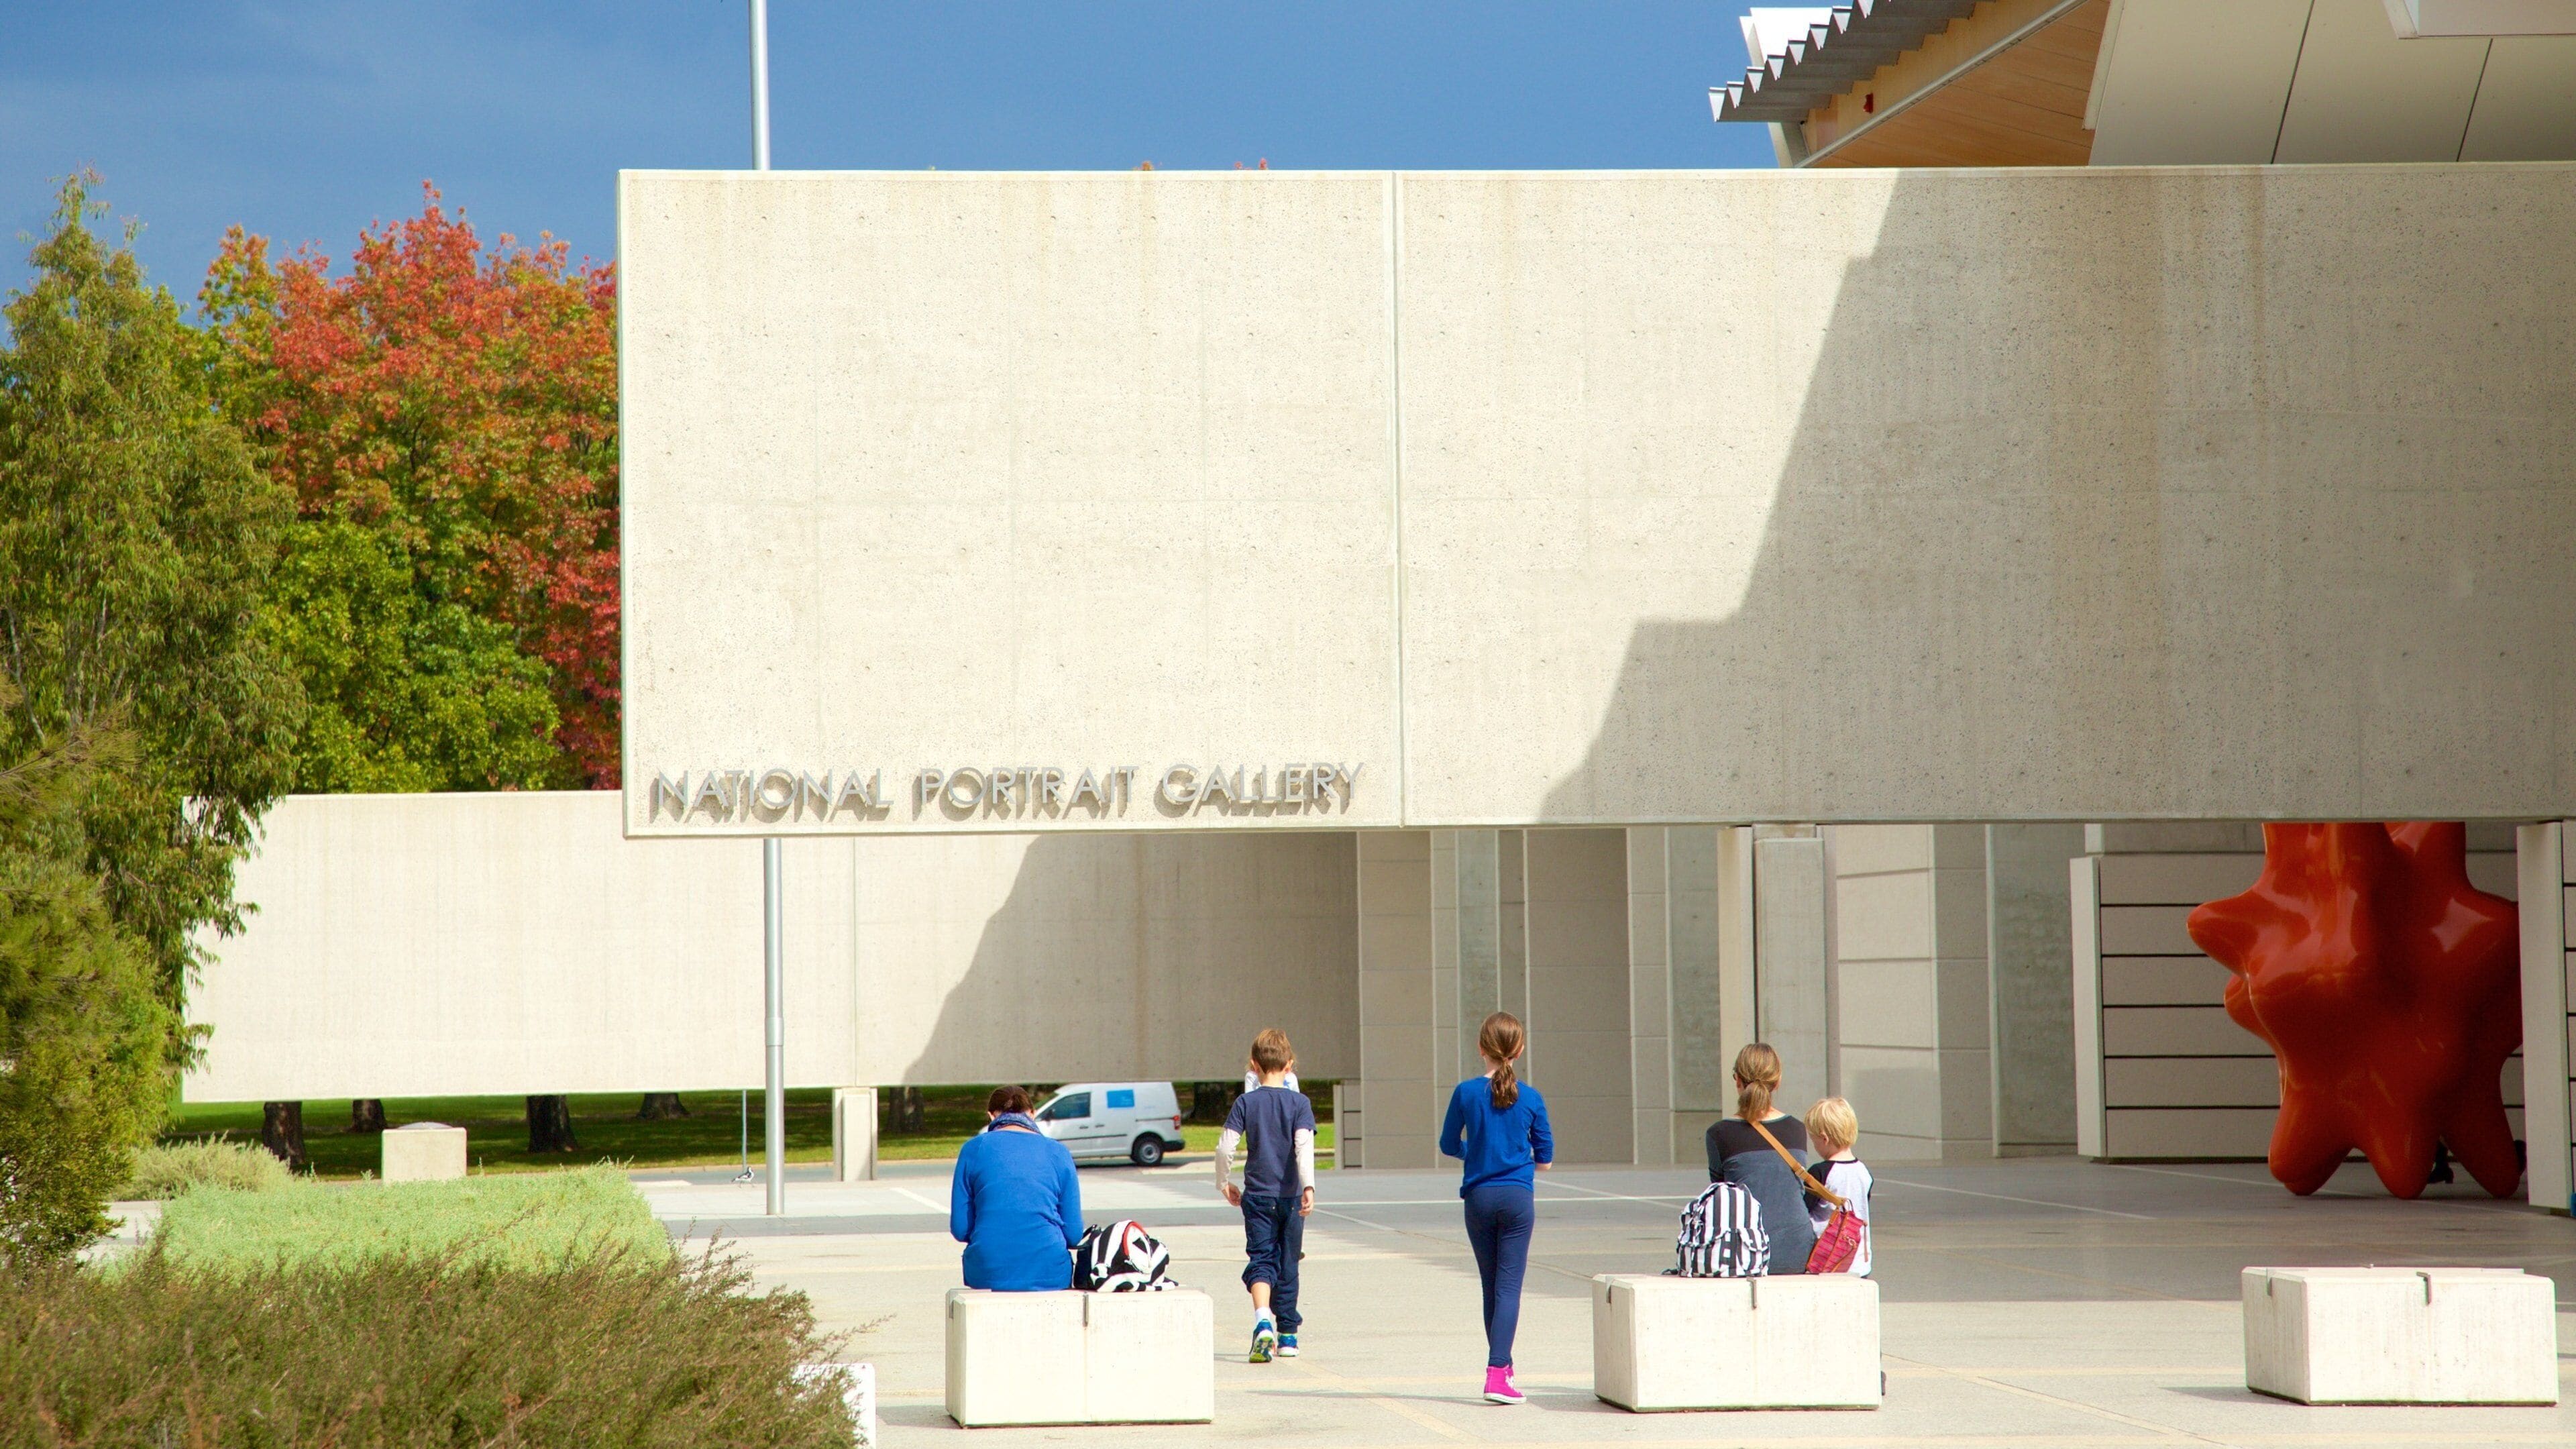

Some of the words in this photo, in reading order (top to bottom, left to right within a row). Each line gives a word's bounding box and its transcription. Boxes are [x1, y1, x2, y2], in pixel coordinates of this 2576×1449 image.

[657, 768, 894, 806] NATIONAL
[920, 765, 1139, 805] PORTRAIT
[1163, 761, 1364, 803] GALLERY
